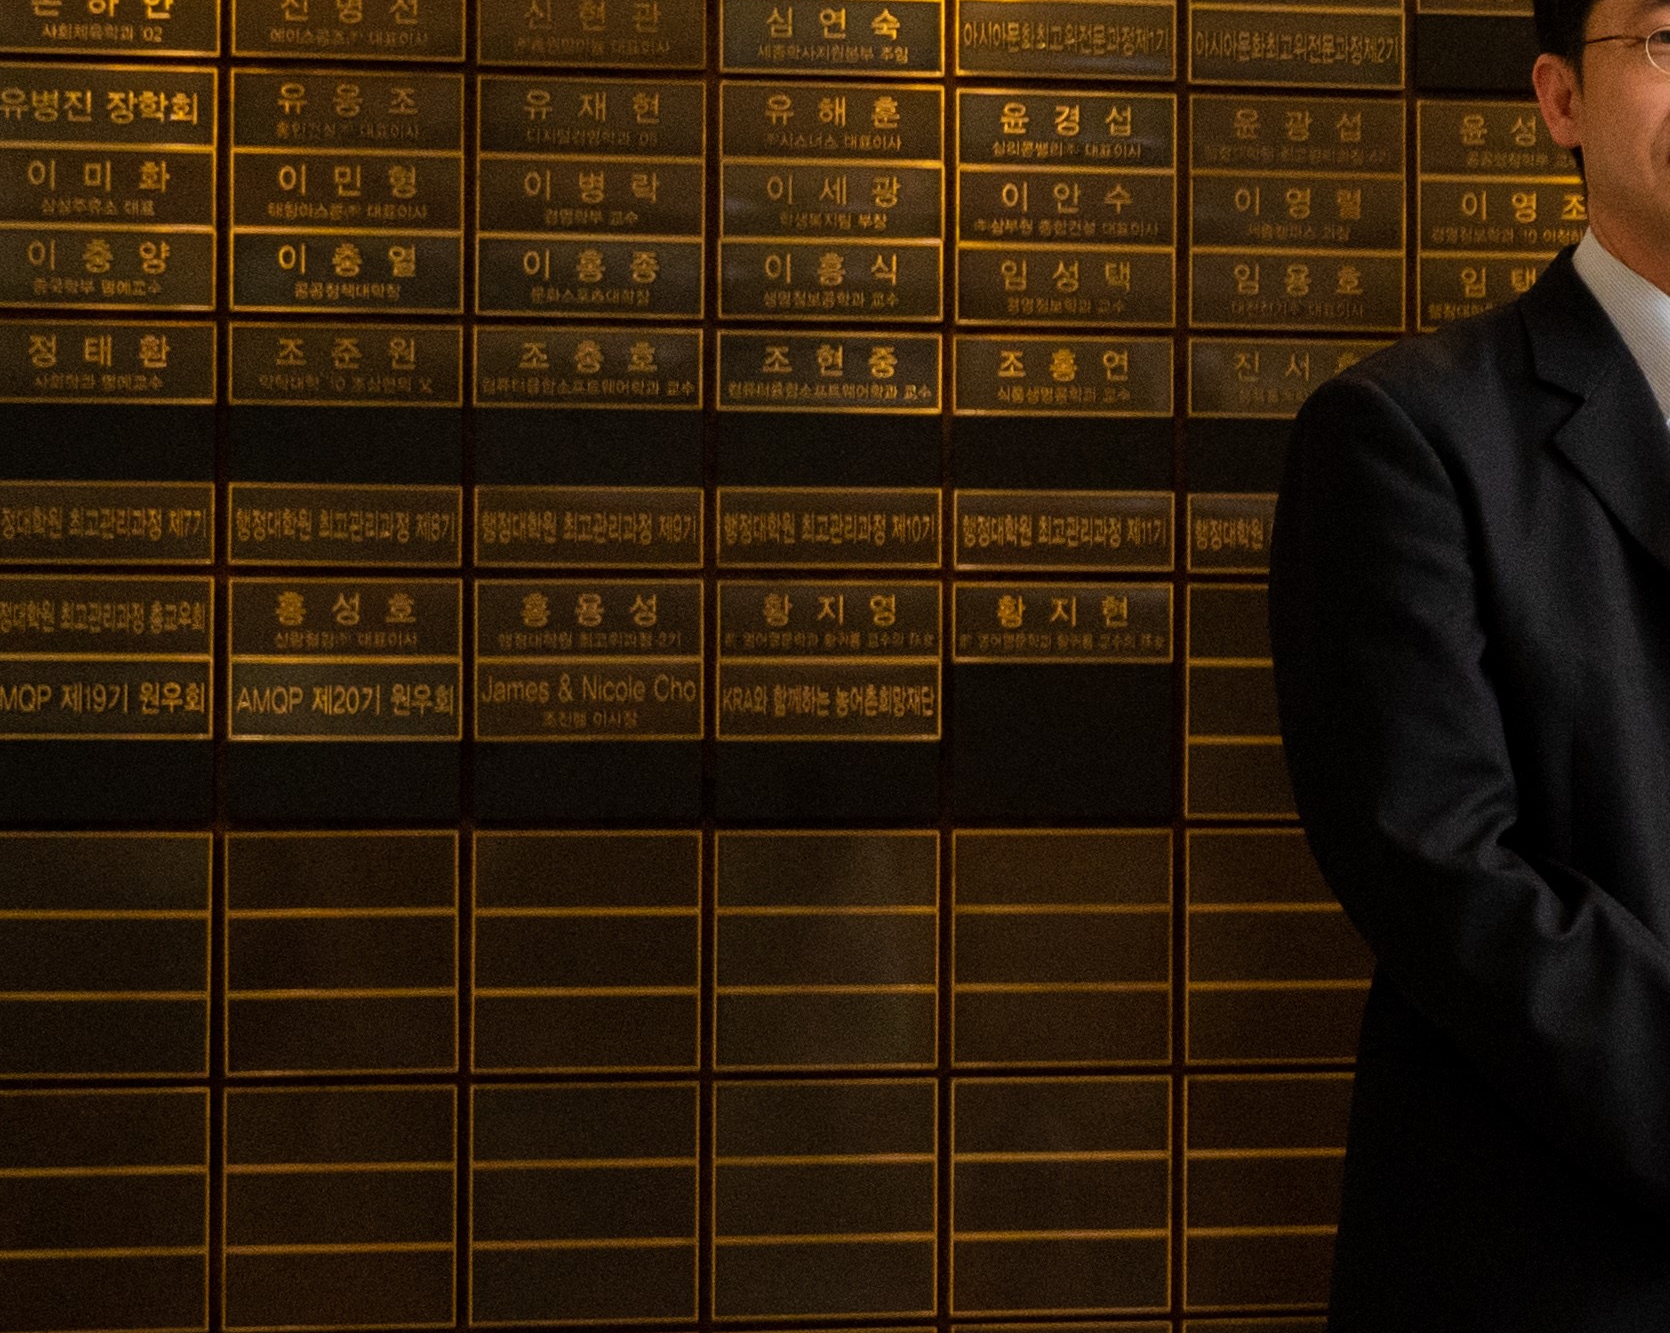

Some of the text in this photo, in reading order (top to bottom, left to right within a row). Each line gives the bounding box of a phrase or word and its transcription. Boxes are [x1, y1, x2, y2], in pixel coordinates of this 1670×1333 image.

[106, 90, 198, 125] 장학회
[60, 683, 206, 715] 제19기 원우회
[236, 683, 454, 716] AMQP 제20기 원우회
[481, 673, 697, 704] James & Nicole Cho
